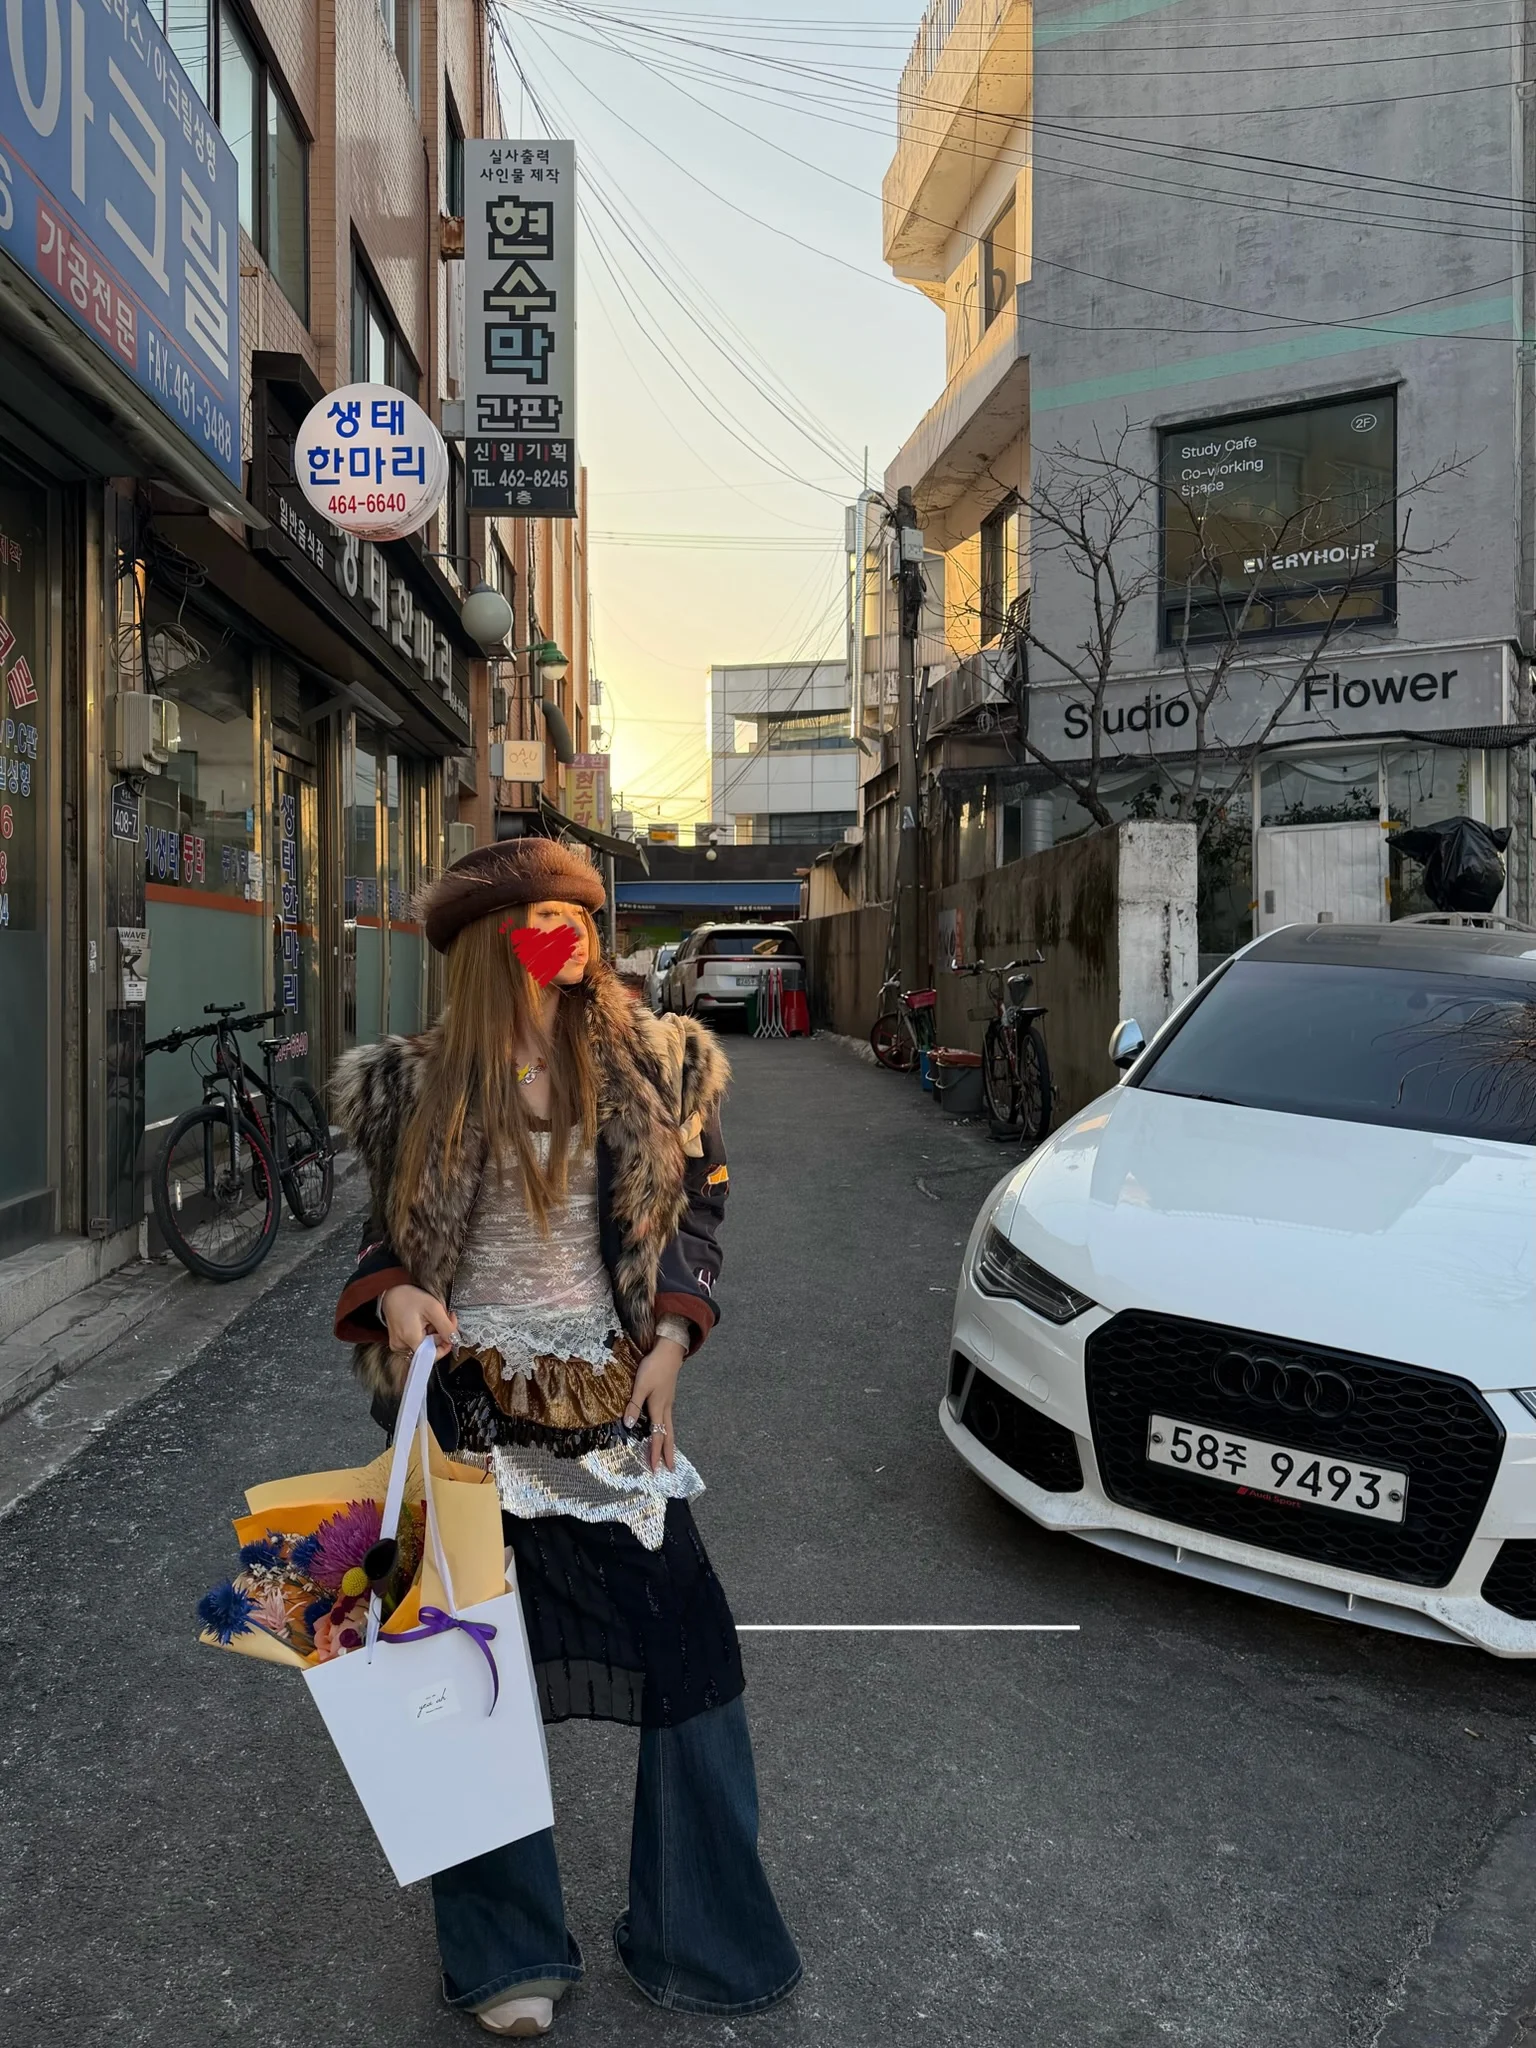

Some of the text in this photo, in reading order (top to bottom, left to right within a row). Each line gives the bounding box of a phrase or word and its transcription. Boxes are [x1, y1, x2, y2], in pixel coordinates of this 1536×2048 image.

[489, 149, 550, 165] 실사출력
[480, 168, 560, 185] 사인물 제작
[41, 210, 135, 360] 가공전문
[483, 195, 556, 385] 현수막
[327, 400, 405, 438] 생태
[477, 394, 563, 432] 간판
[1355, 417, 1371, 430] 2F
[1181, 436, 1258, 460] Study Cafe
[307, 446, 426, 485] 한마리
[1181, 459, 1264, 481] Co-working
[472, 468, 568, 488] TEL. 462-8245
[1181, 480, 1224, 498] Space
[328, 493, 406, 514] 464-6640
[504, 491, 533, 505] 1층
[279, 497, 325, 570] 일반음식점
[1063, 668, 1458, 740] Sudio Flower
[1170, 1426, 1382, 1510] 58주 9493
[1249, 1490, 1302, 1508] Audi Sport
